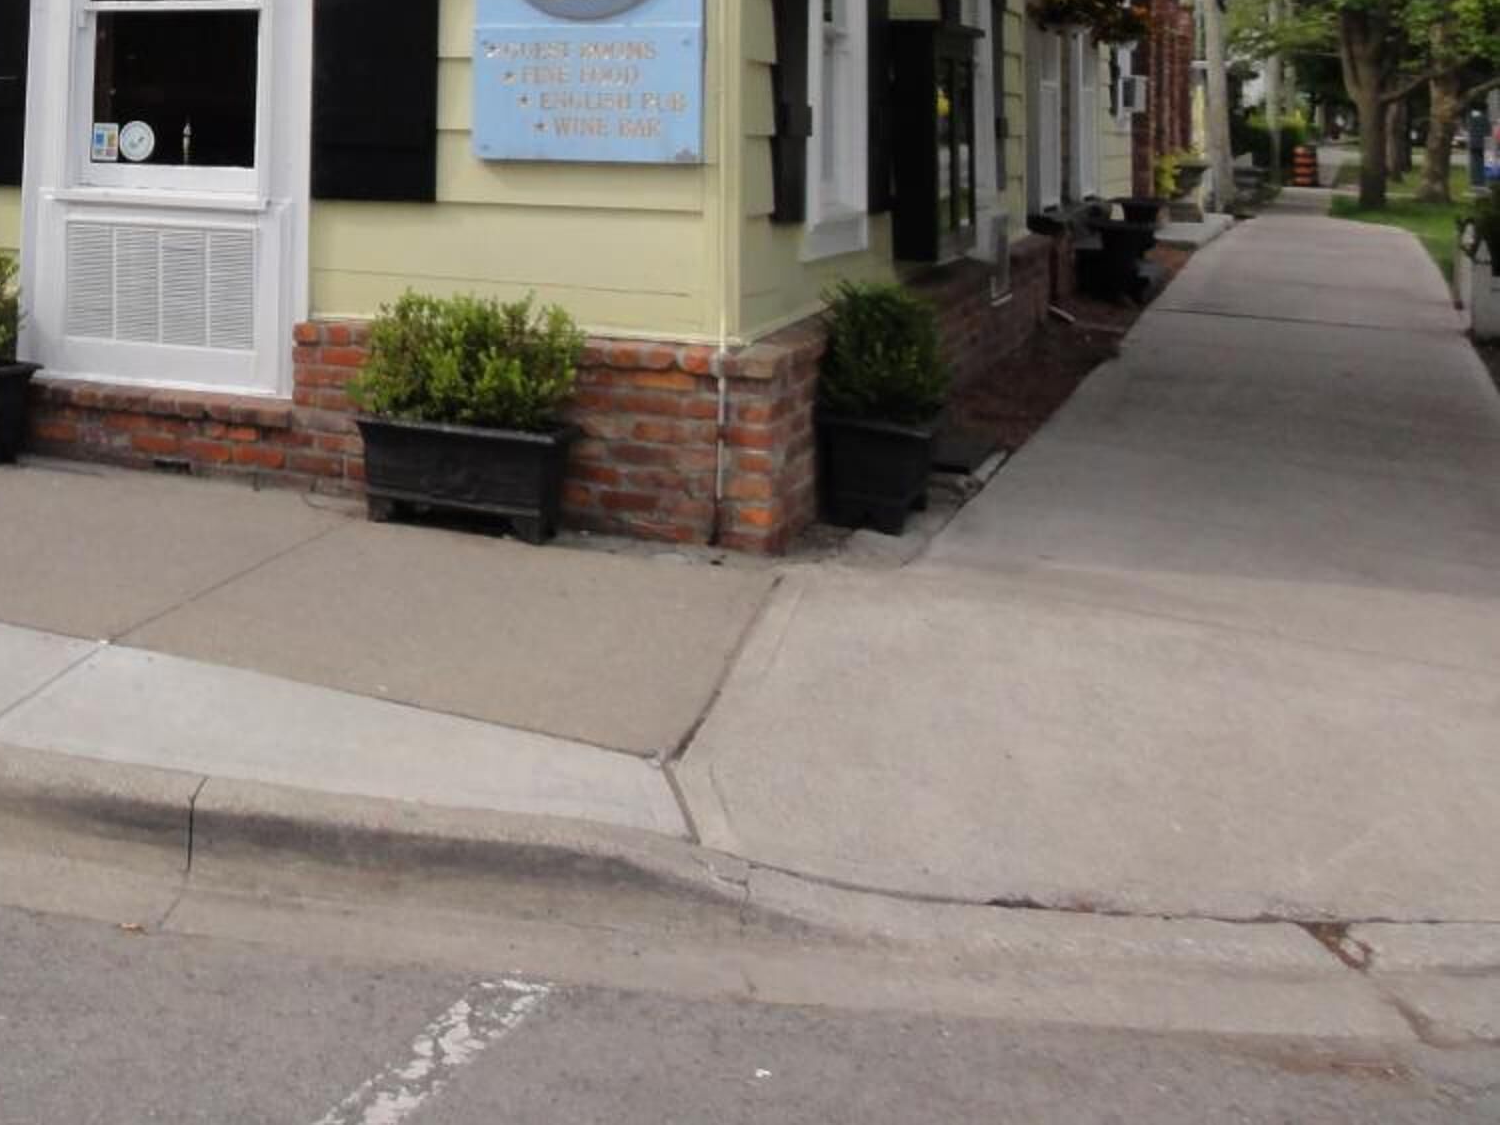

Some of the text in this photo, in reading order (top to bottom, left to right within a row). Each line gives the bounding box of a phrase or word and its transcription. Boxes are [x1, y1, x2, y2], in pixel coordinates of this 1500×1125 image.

[539, 90, 630, 111] ENGLISH
[553, 117, 661, 140] WINE BAR
